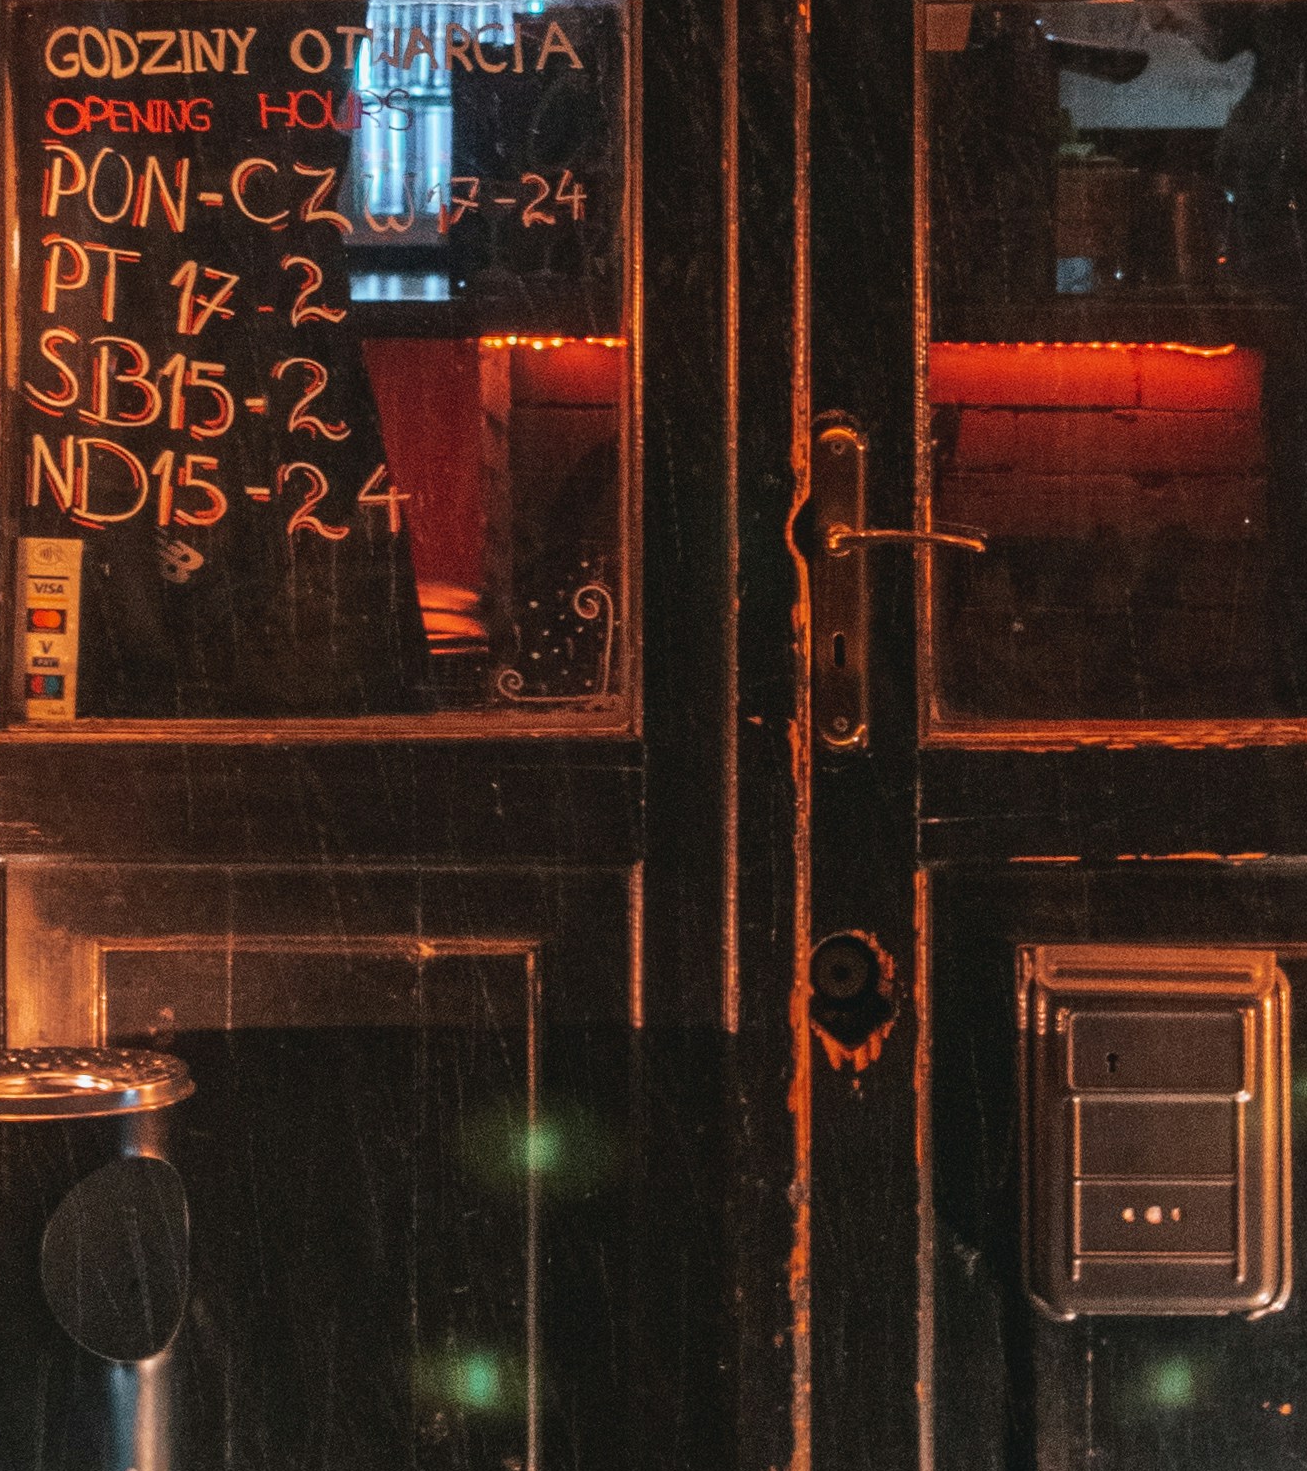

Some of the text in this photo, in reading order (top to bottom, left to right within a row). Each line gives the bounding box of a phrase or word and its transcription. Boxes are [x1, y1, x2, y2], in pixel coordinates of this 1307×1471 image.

[45, 21, 584, 79] GODZINY OTWARCIA
[45, 89, 411, 136] OPENING HOURS
[43, 233, 142, 323] PT
[34, 582, 64, 595] VISA
